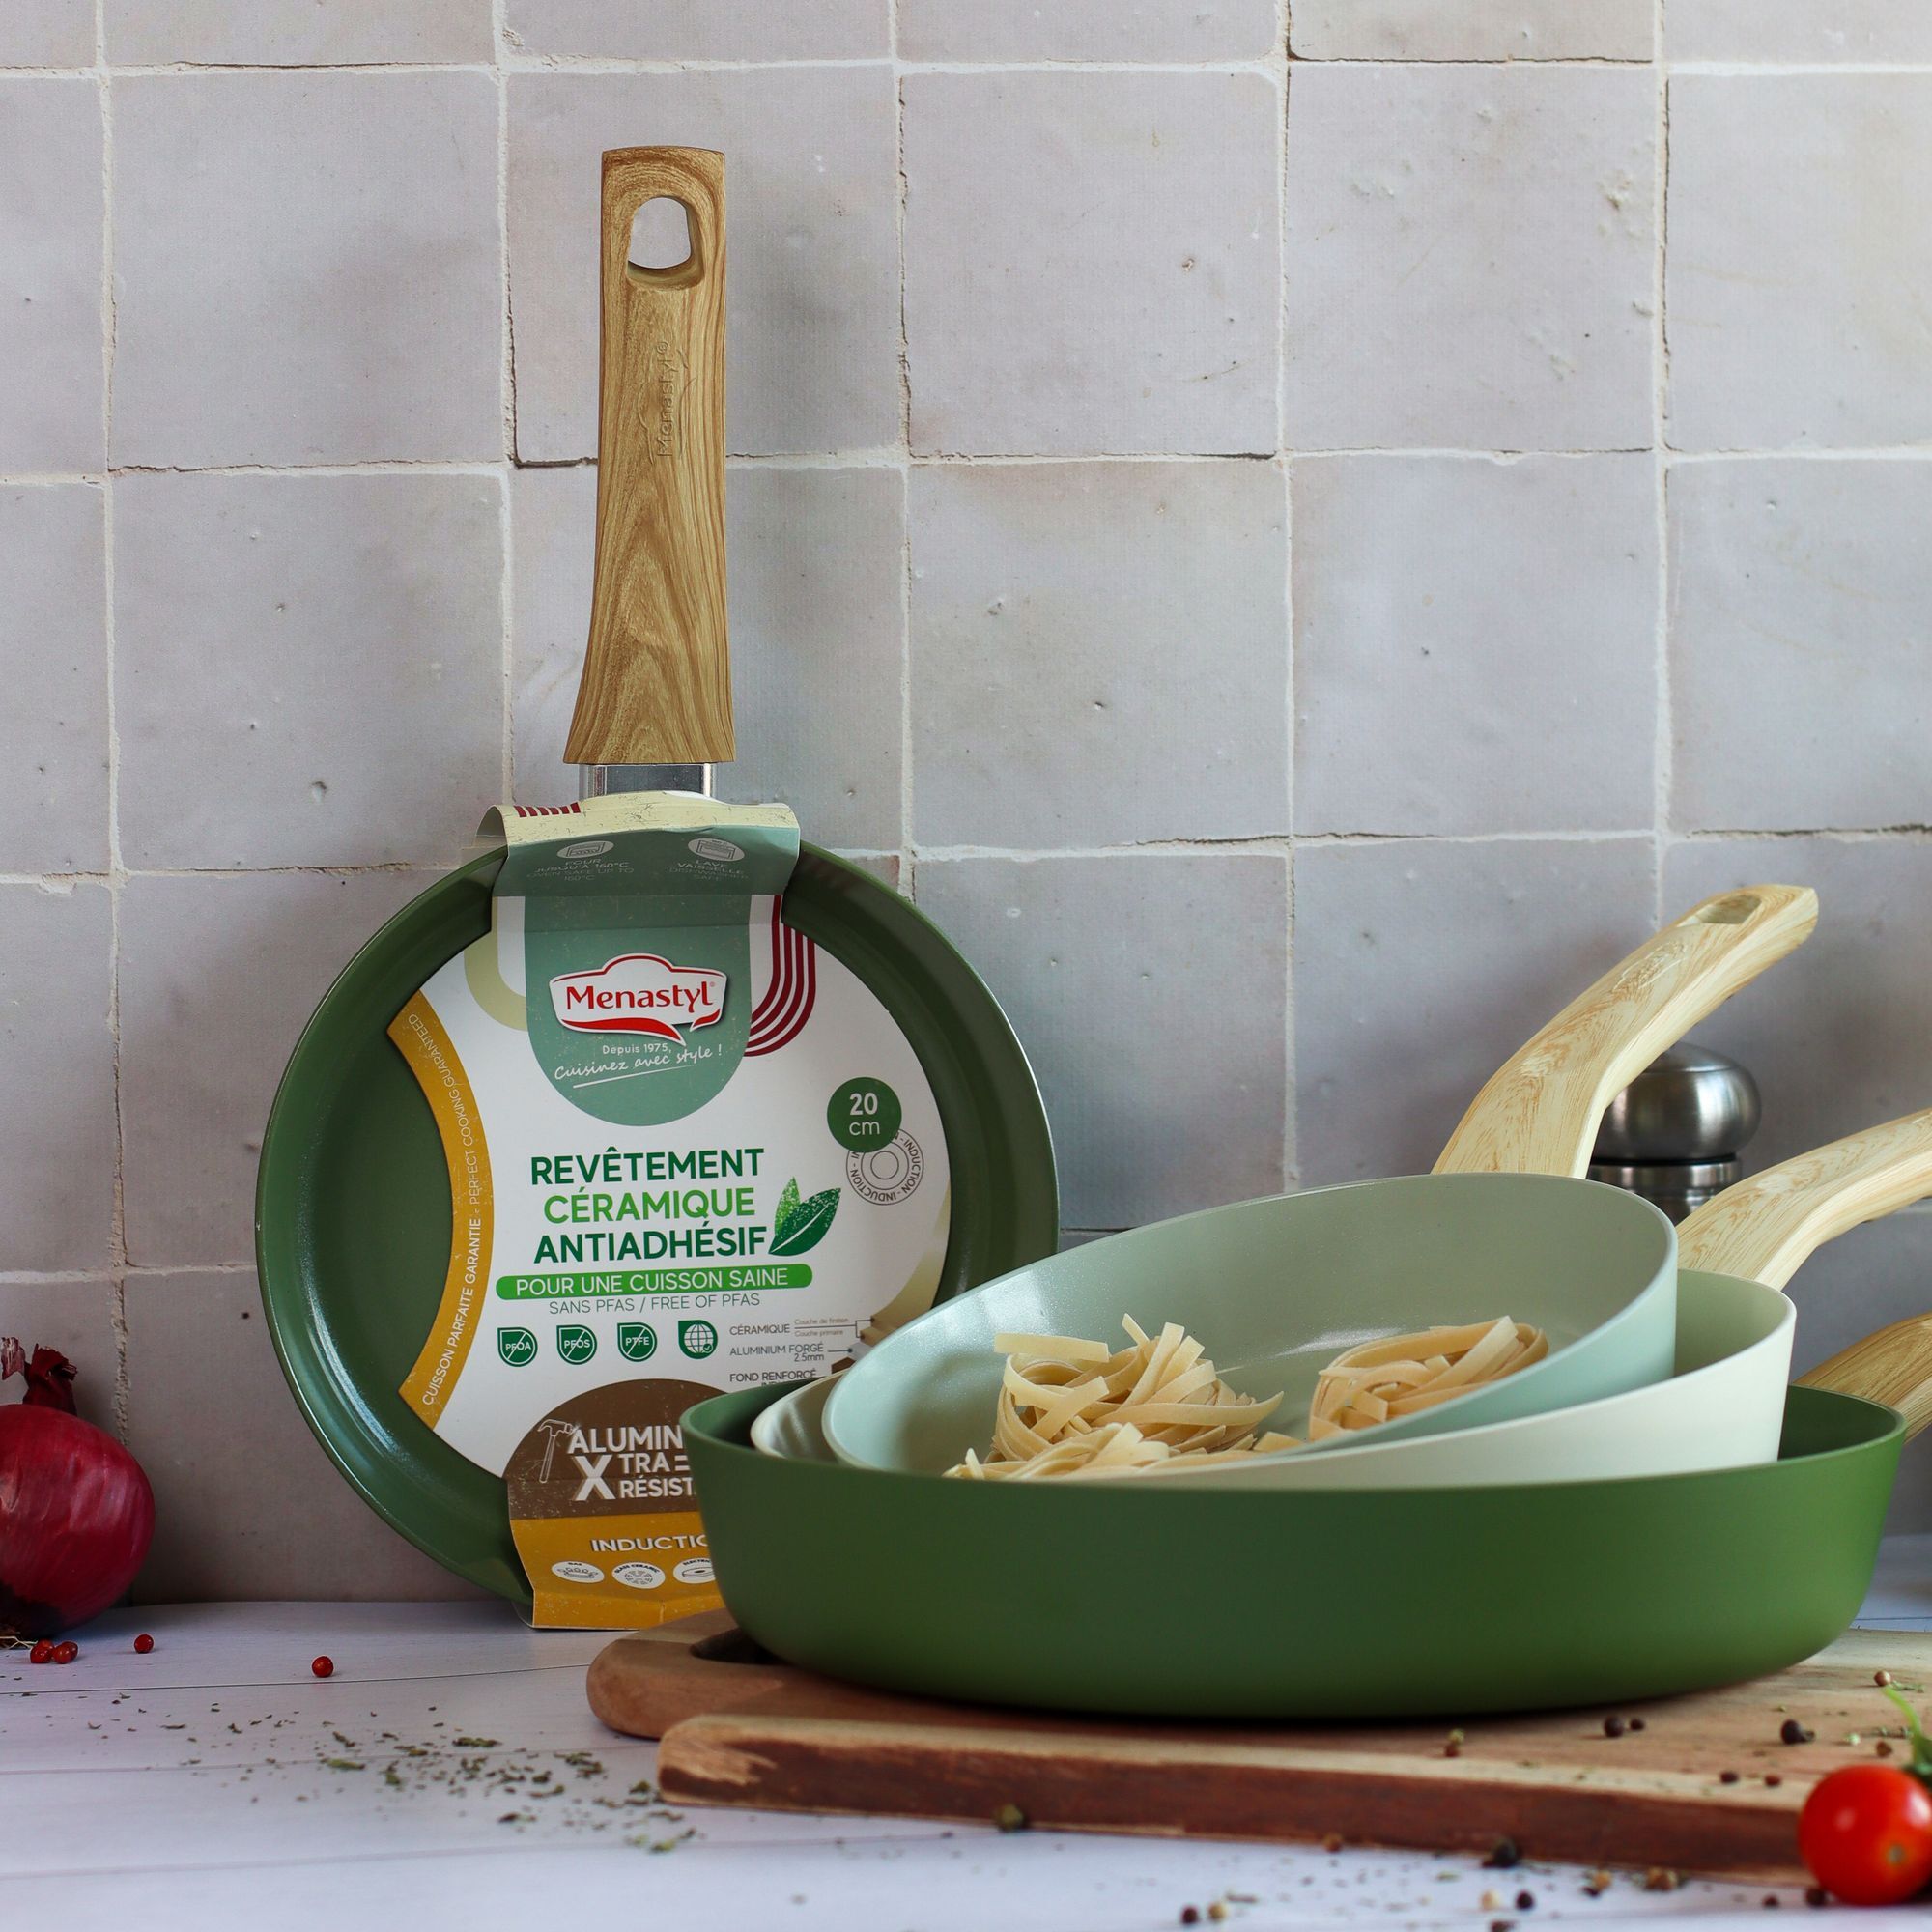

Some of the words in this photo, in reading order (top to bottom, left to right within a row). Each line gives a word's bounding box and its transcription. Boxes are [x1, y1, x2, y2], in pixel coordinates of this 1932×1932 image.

[408, 1014, 455, 1088] GUARANTEED
[554, 1061, 629, 1080] Cuisinez
[634, 1055, 670, 1068] avec
[676, 1045, 713, 1064] style
[602, 1044, 640, 1056] Depuis
[448, 1089, 473, 1147] COOKING
[849, 1092, 878, 1116] 20
[849, 1121, 880, 1135] cm
[465, 1150, 480, 1205] PERFECT
[530, 1146, 765, 1185] REVÊTEMENT
[903, 1139, 922, 1194] INDUCTION
[849, 1169, 897, 1203] INDUCTION
[544, 1186, 755, 1224] CÉRAMIQUE
[465, 1218, 482, 1285] GARANTIE
[533, 1220, 767, 1264] ANTIADHÉSIF
[516, 1276, 575, 1295] POUR
[582, 1274, 623, 1293] UNE
[629, 1271, 724, 1292] CUISSON
[729, 1267, 788, 1288] SAINE
[447, 1287, 474, 1348] PARFAITE
[549, 1299, 591, 1315] SANS
[596, 1297, 635, 1313] PFAS
[651, 1295, 691, 1310] FREE
[695, 1294, 718, 1309] OF
[723, 1293, 761, 1307] PFAS
[564, 1339, 591, 1349] PFOS
[625, 1336, 651, 1347] PTFE
[729, 1323, 791, 1336] CÉRAMIQUE
[505, 1342, 532, 1351] PFOA
[729, 1345, 786, 1356] ALUMINIUM
[788, 1342, 824, 1353] FORGÉ
[422, 1350, 456, 1406] CUISSON
[729, 1373, 759, 1382] FOND
[574, 1454, 616, 1501] X
[617, 1452, 671, 1474] TRA
[619, 1474, 696, 1498] RÉSIST
